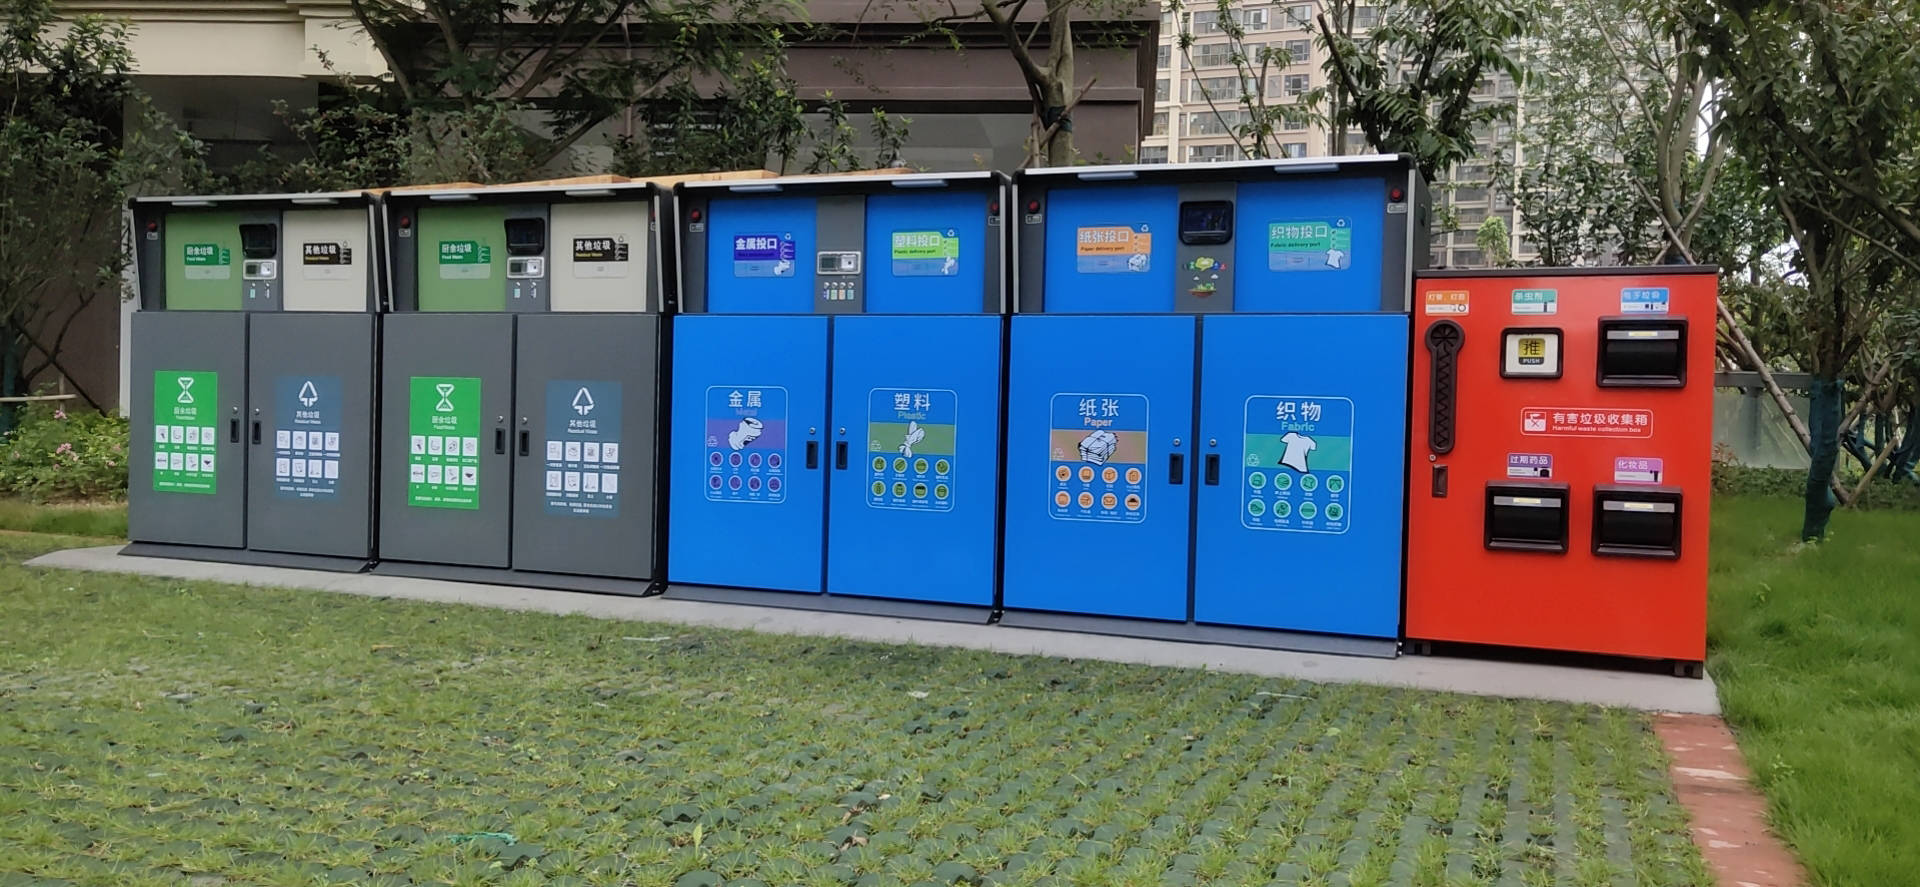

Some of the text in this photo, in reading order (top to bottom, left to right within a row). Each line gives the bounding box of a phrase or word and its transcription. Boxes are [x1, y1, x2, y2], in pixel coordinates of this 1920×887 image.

[1079, 230, 1129, 243] 纸张投口
[1271, 225, 1328, 239] 织物投口
[576, 240, 611, 251] 其他垃圾
[735, 237, 777, 250] 金属投口
[895, 234, 940, 248] 塑料投口
[305, 245, 337, 255] 其他垃圾
[1522, 340, 1541, 355] 推
[728, 390, 762, 408] 金属
[894, 392, 931, 411] 塑料
[1078, 397, 1120, 418] 纸张
[1276, 401, 1322, 422] 织物
[897, 411, 927, 420] Plastic
[1552, 412, 1648, 426] 有害垃圾收集箱
[1084, 417, 1113, 428] Paper
[1281, 421, 1315, 432] Fabric
[1510, 455, 1549, 465] 过期药品
[1617, 460, 1649, 470] 化妆品
